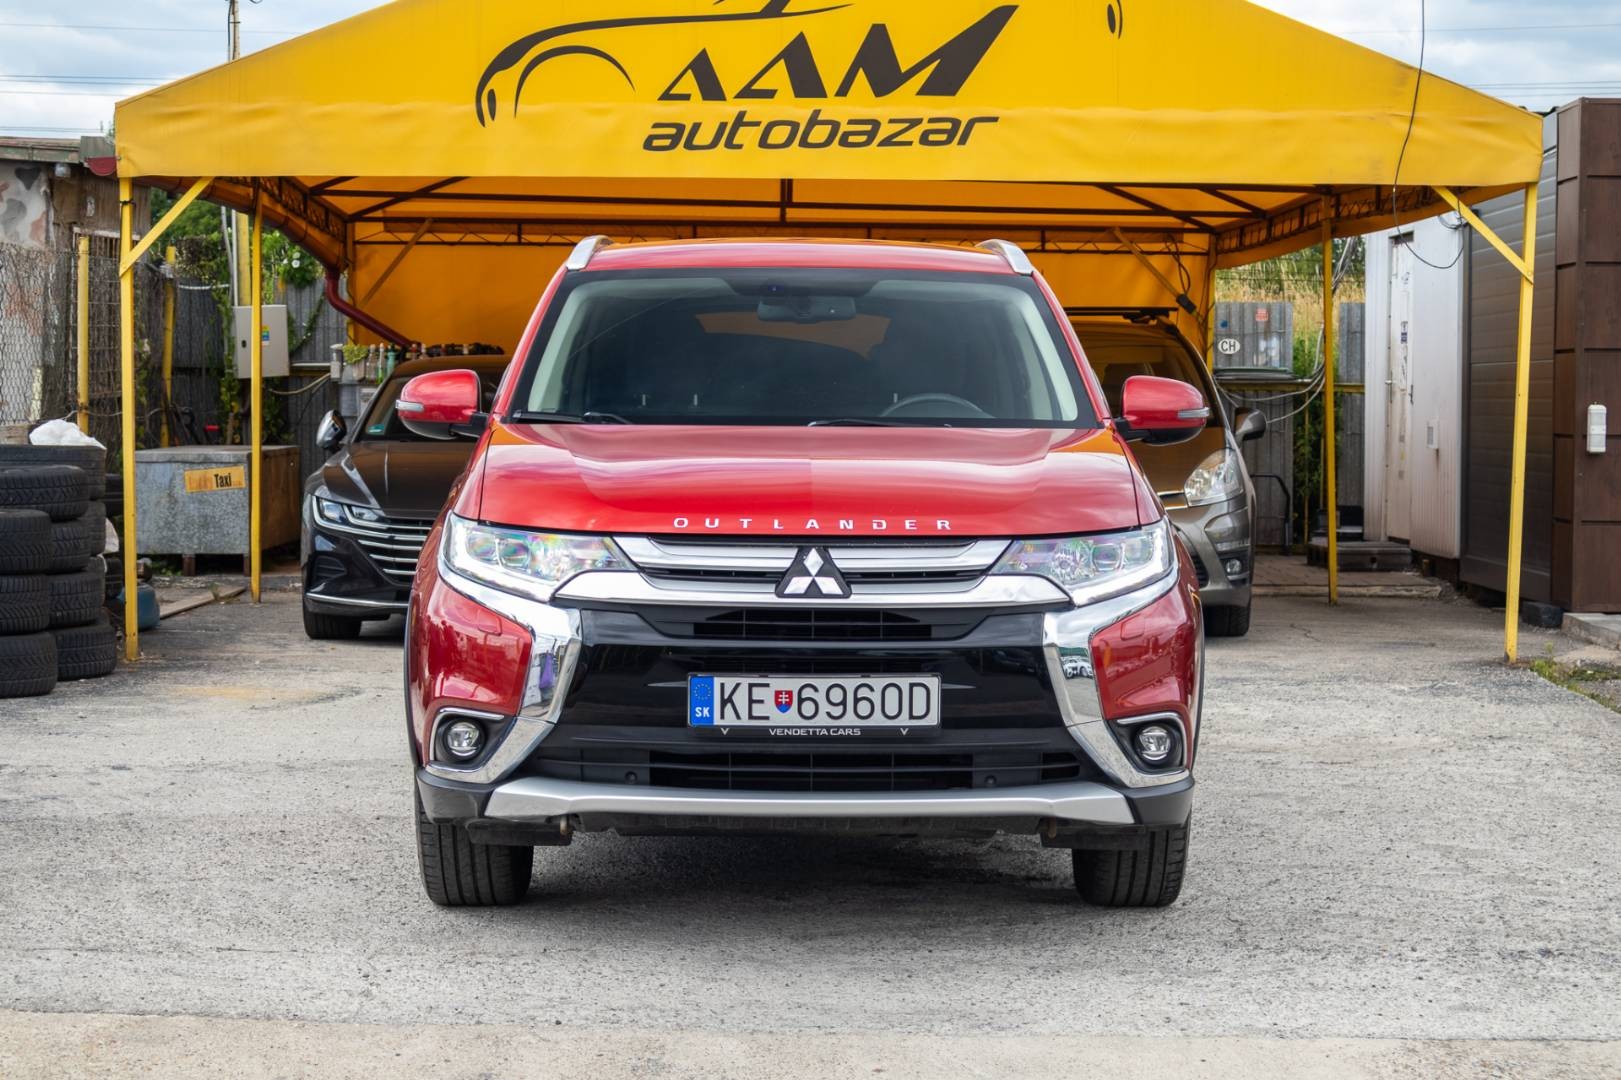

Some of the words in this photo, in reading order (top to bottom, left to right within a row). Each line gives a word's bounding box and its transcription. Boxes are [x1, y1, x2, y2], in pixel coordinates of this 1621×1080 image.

[656, 4, 1019, 102] AAM
[642, 109, 1000, 152] autobazar
[1220, 339, 1236, 352] CH
[214, 472, 232, 488] Taxi
[673, 517, 951, 530] OUTLANDER
[719, 682, 771, 721] KE
[695, 706, 710, 718] SK
[768, 728, 829, 736] VENDETTA
[830, 728, 862, 736] CARS
